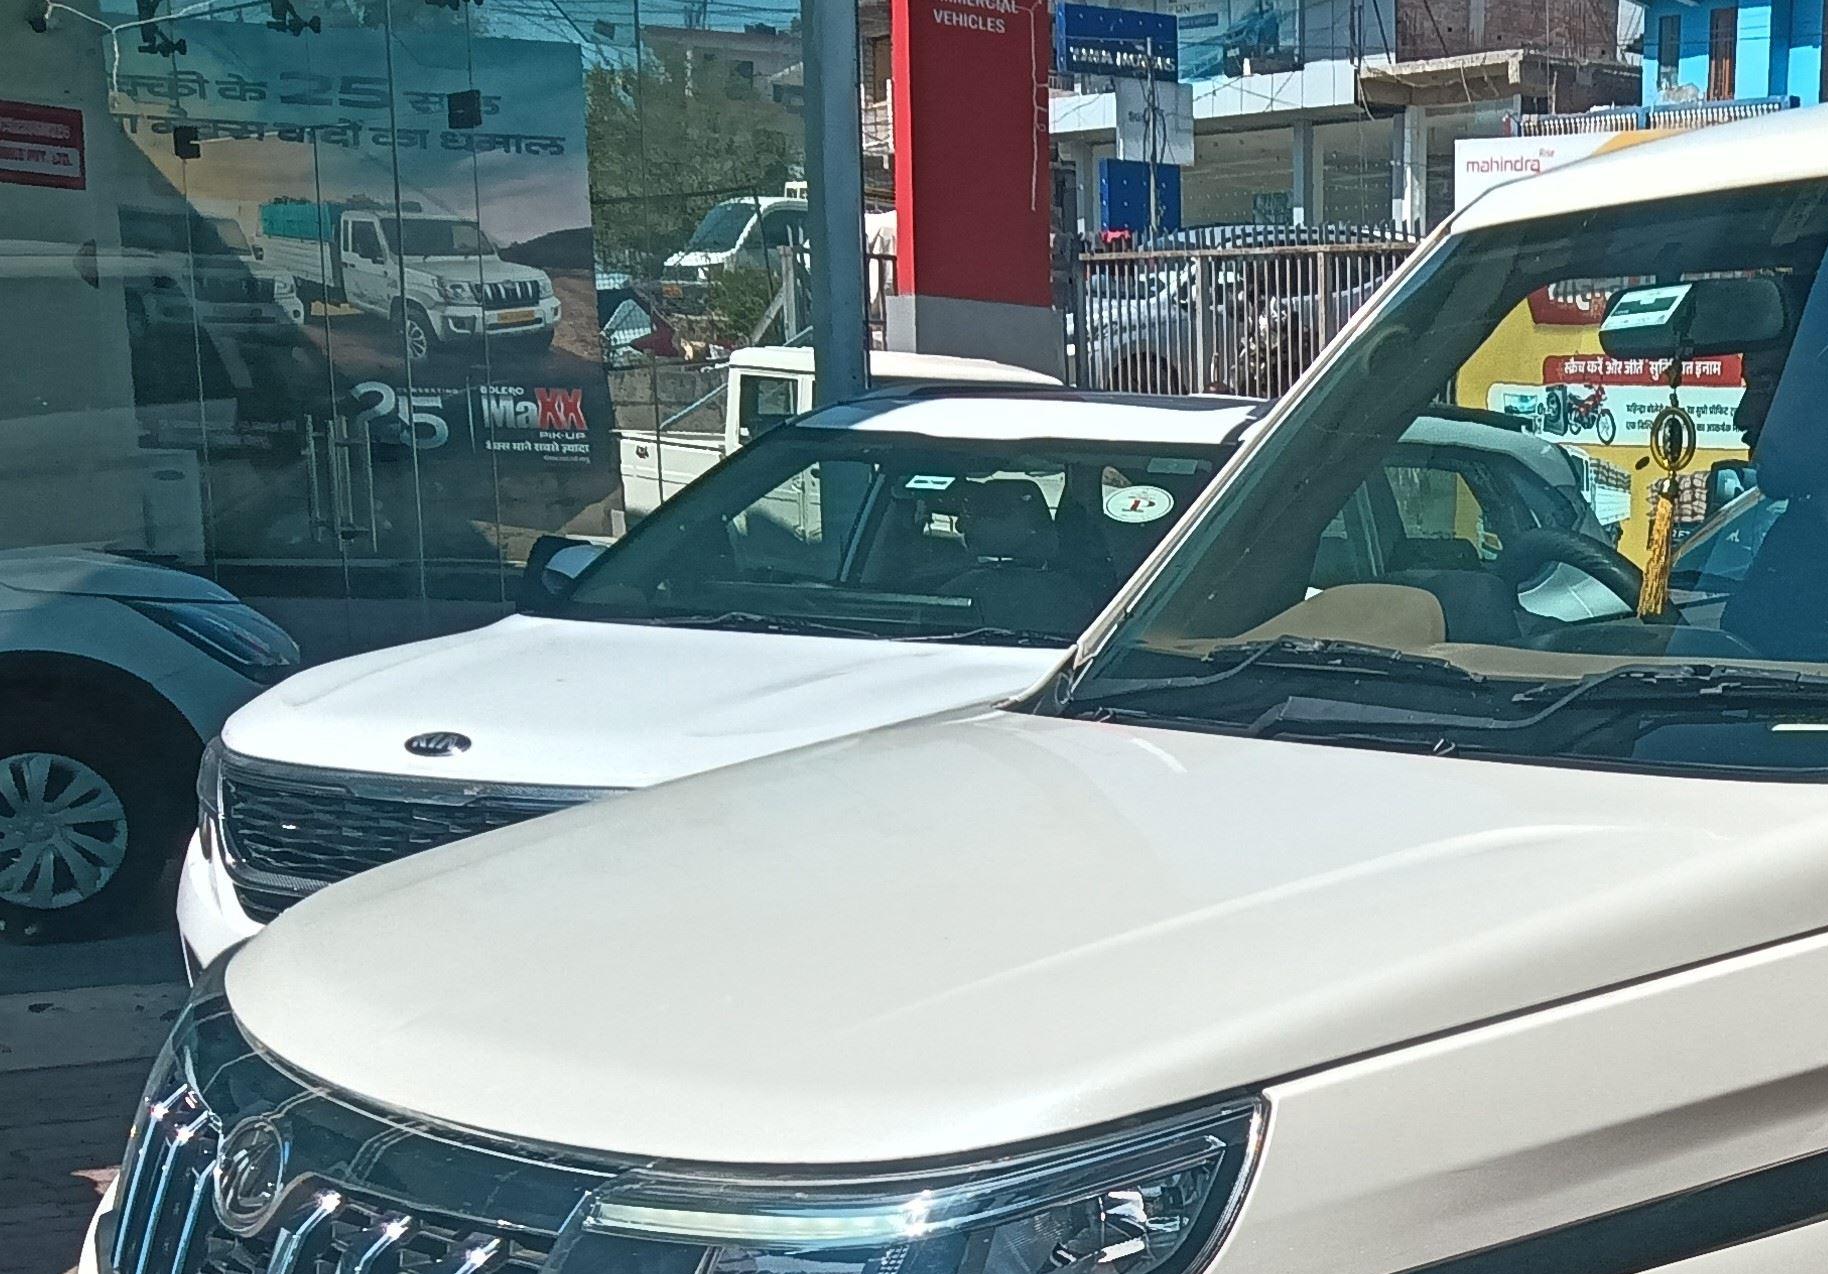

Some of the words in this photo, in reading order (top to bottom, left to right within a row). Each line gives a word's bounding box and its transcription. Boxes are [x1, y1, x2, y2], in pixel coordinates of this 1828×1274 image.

[933, 8, 1006, 34] VEHICLES
[279, 71, 394, 109] 25
[1466, 157, 1541, 174] mahindra
[1605, 358, 1623, 376] और
[1695, 361, 1722, 379] इनाम
[480, 385, 525, 396] BOLERO
[351, 381, 450, 450] 25
